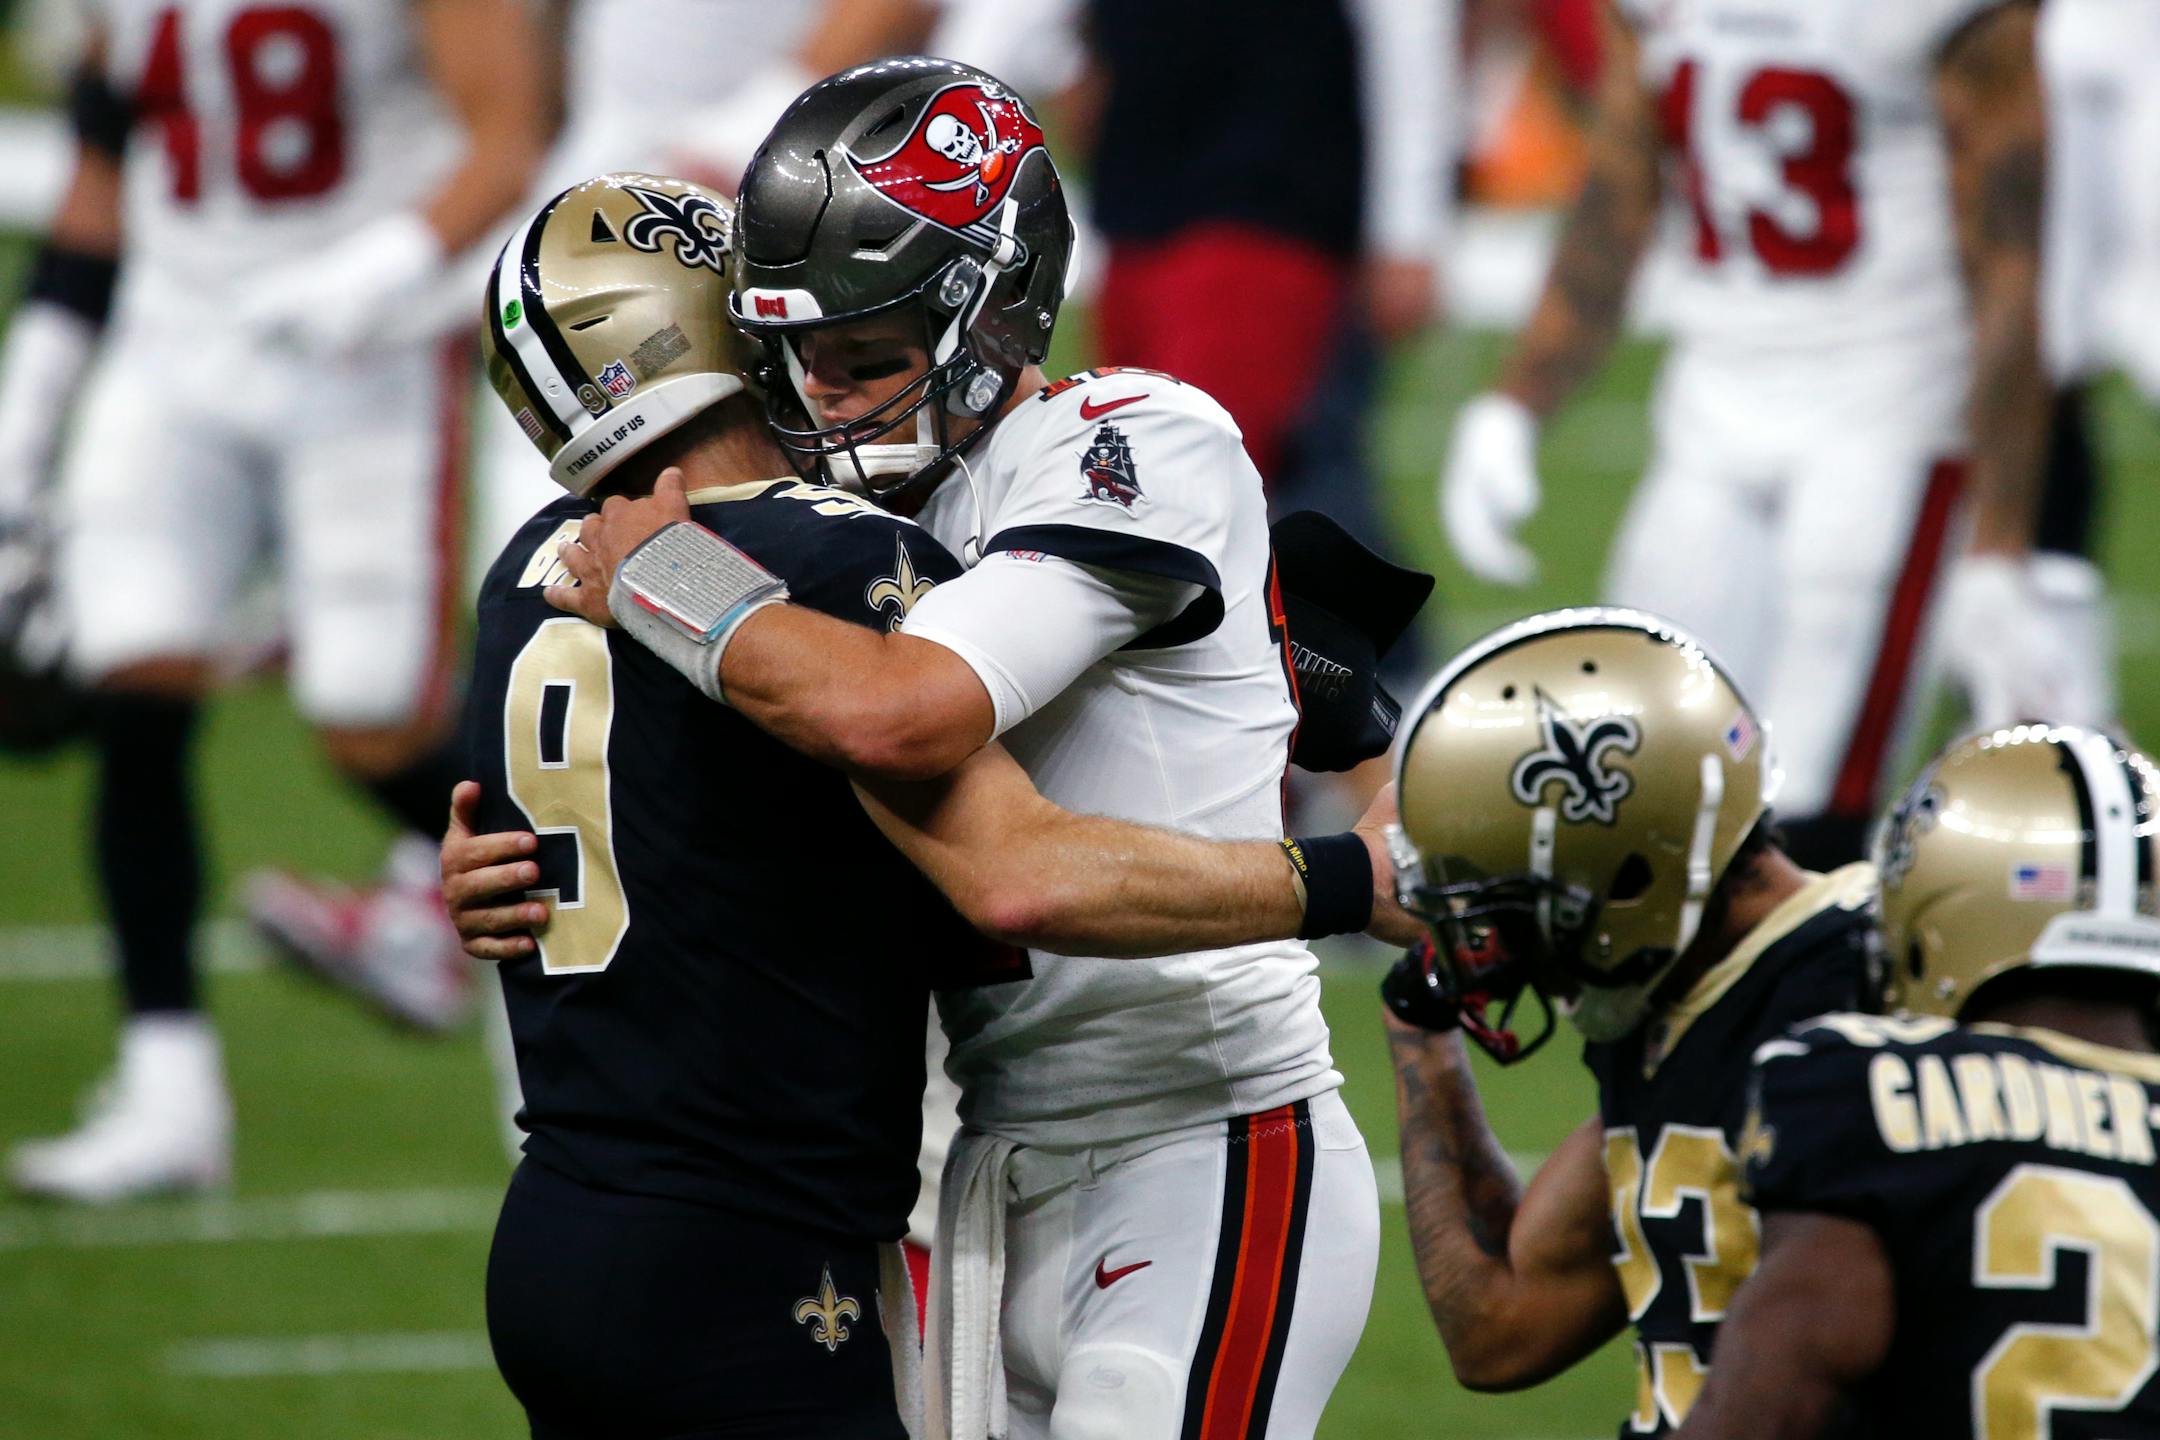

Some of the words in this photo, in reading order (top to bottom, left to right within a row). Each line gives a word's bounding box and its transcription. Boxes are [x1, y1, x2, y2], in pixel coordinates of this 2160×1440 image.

[573, 449, 599, 471] TAKES
[596, 438, 617, 455] ALL
[613, 425, 629, 441] OF
[627, 415, 646, 431] US
[577, 383, 607, 414] 9
[504, 617, 631, 976] 9
[1971, 1163, 2160, 1440] 2
